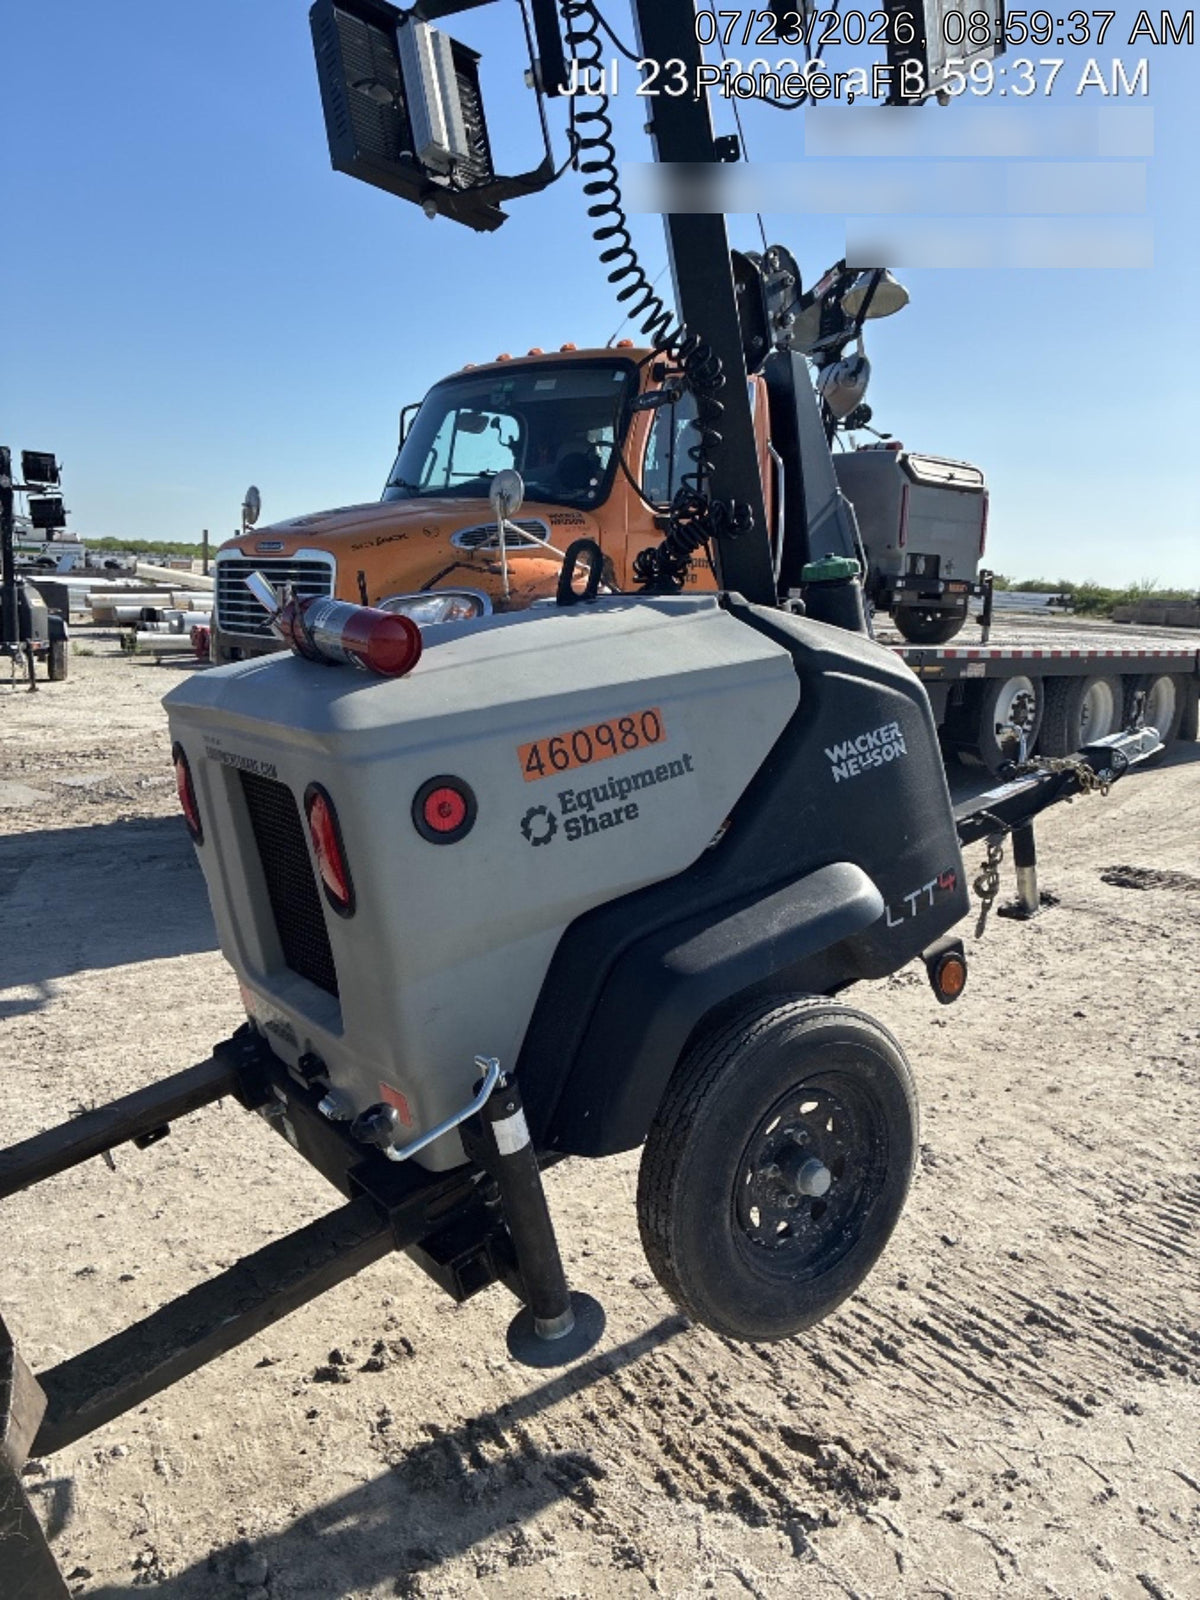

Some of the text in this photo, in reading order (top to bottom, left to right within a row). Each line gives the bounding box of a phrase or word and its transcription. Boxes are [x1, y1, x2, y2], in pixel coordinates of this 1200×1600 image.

[525, 709, 661, 776] 460980
[823, 721, 903, 764] WACKER
[830, 738, 909, 784] NEUSON
[556, 752, 695, 815] Equipment
[562, 802, 640, 842] Share
